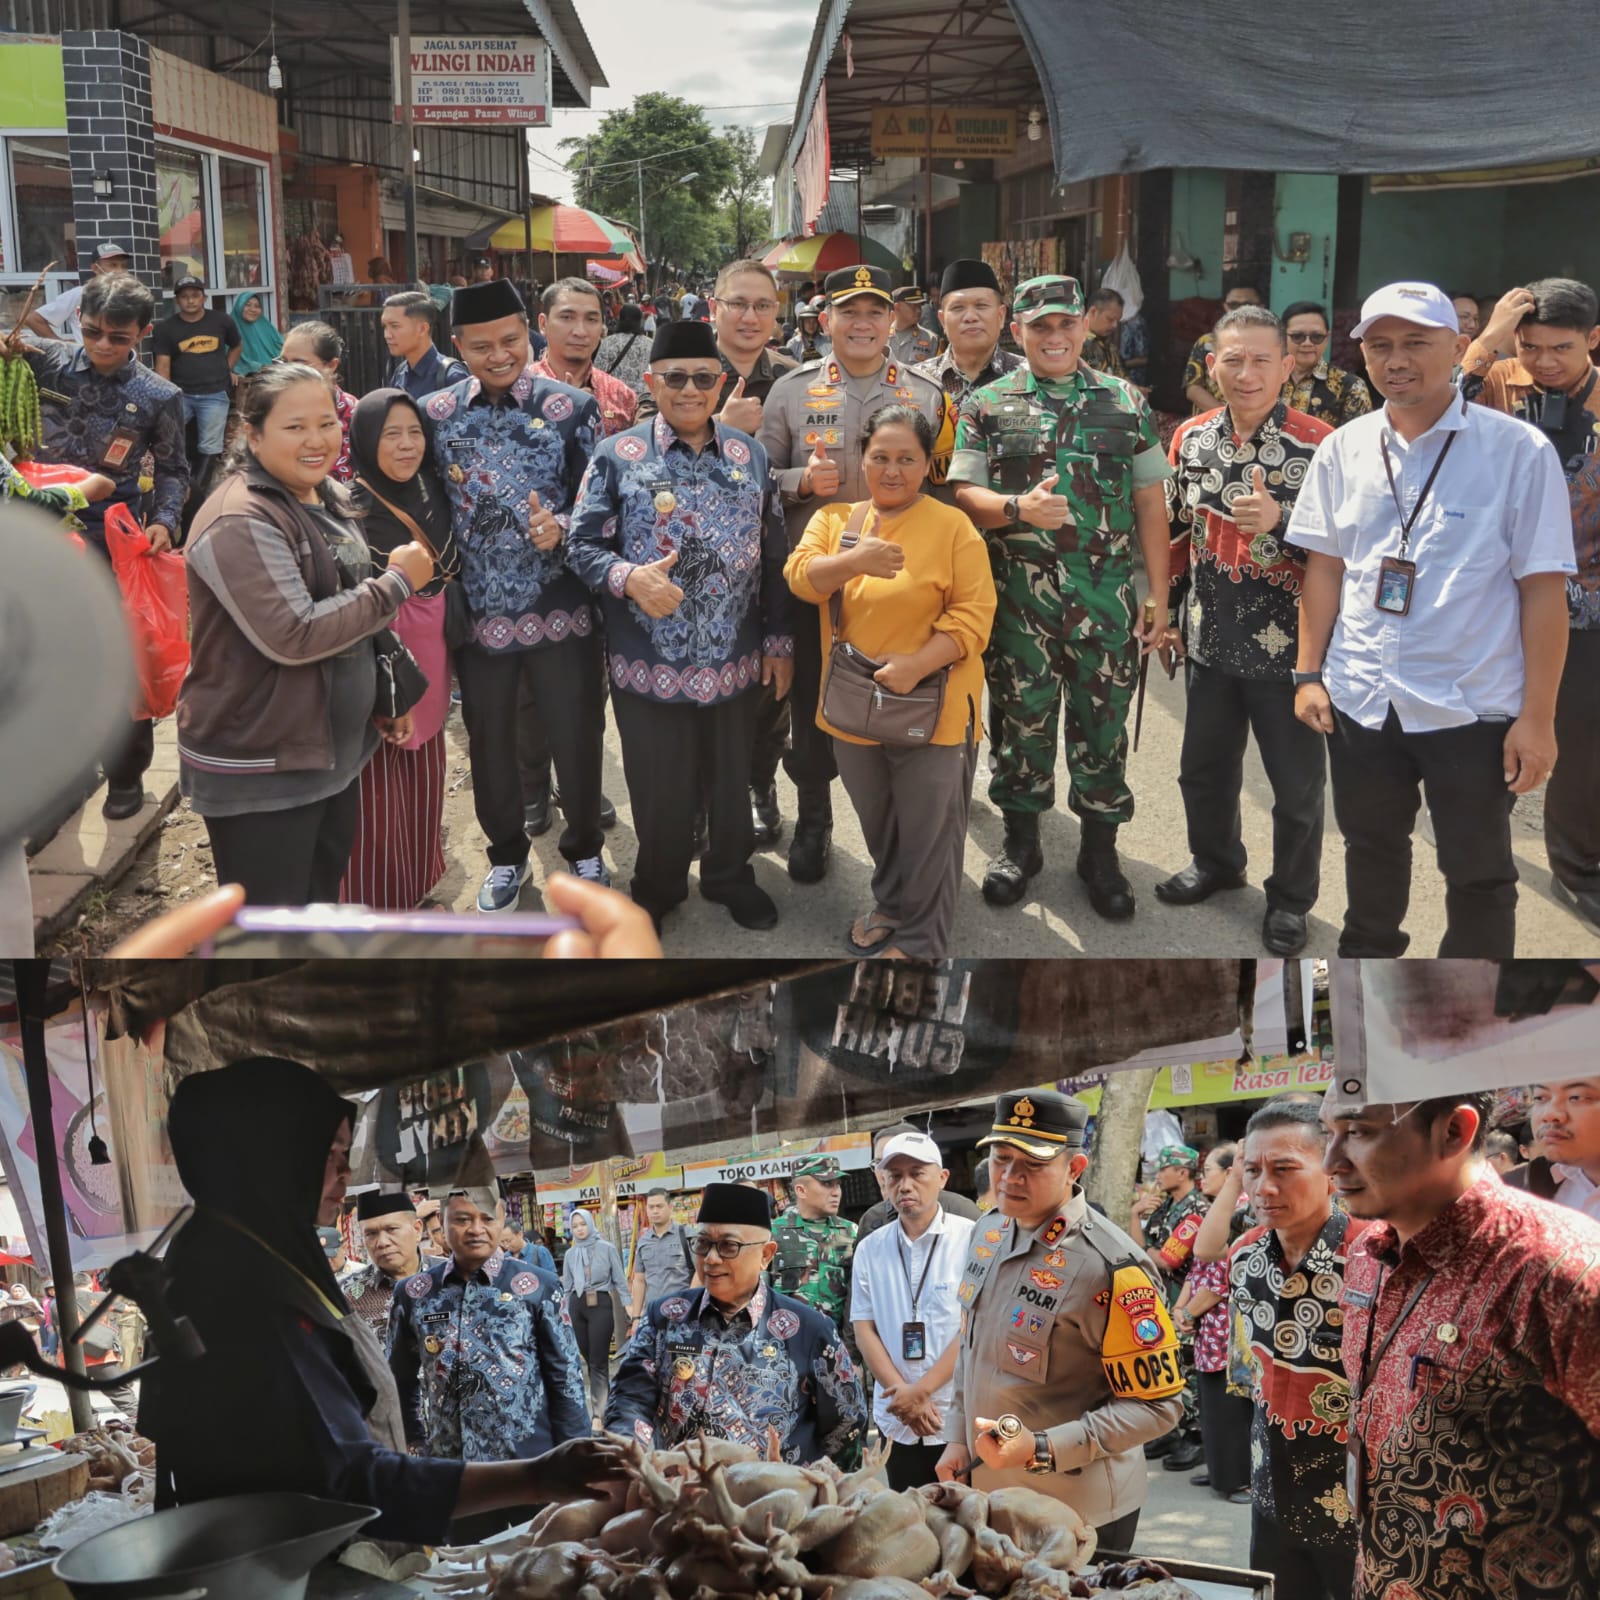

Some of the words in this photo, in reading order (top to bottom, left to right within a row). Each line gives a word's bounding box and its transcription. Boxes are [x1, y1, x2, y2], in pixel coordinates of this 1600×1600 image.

[424, 41, 456, 50] JAGAL
[458, 41, 482, 50] SAPI
[484, 41, 518, 50] SEHAT
[477, 54, 536, 72] INDAH
[424, 109, 469, 121] Lapangan
[475, 109, 502, 118] Pasar
[507, 109, 537, 121] Wlingi
[956, 136, 1001, 144] CHANNEL
[806, 414, 838, 425] ARIF
[1298, 1061, 1334, 1084] leb
[718, 1166, 756, 1181] TOKO
[967, 1262, 985, 1278] ARIF
[1018, 1286, 1057, 1311] POLRI
[1120, 1289, 1154, 1304] POLRES
[1105, 1361, 1133, 1392] KA
[1134, 1351, 1174, 1389] OPS
